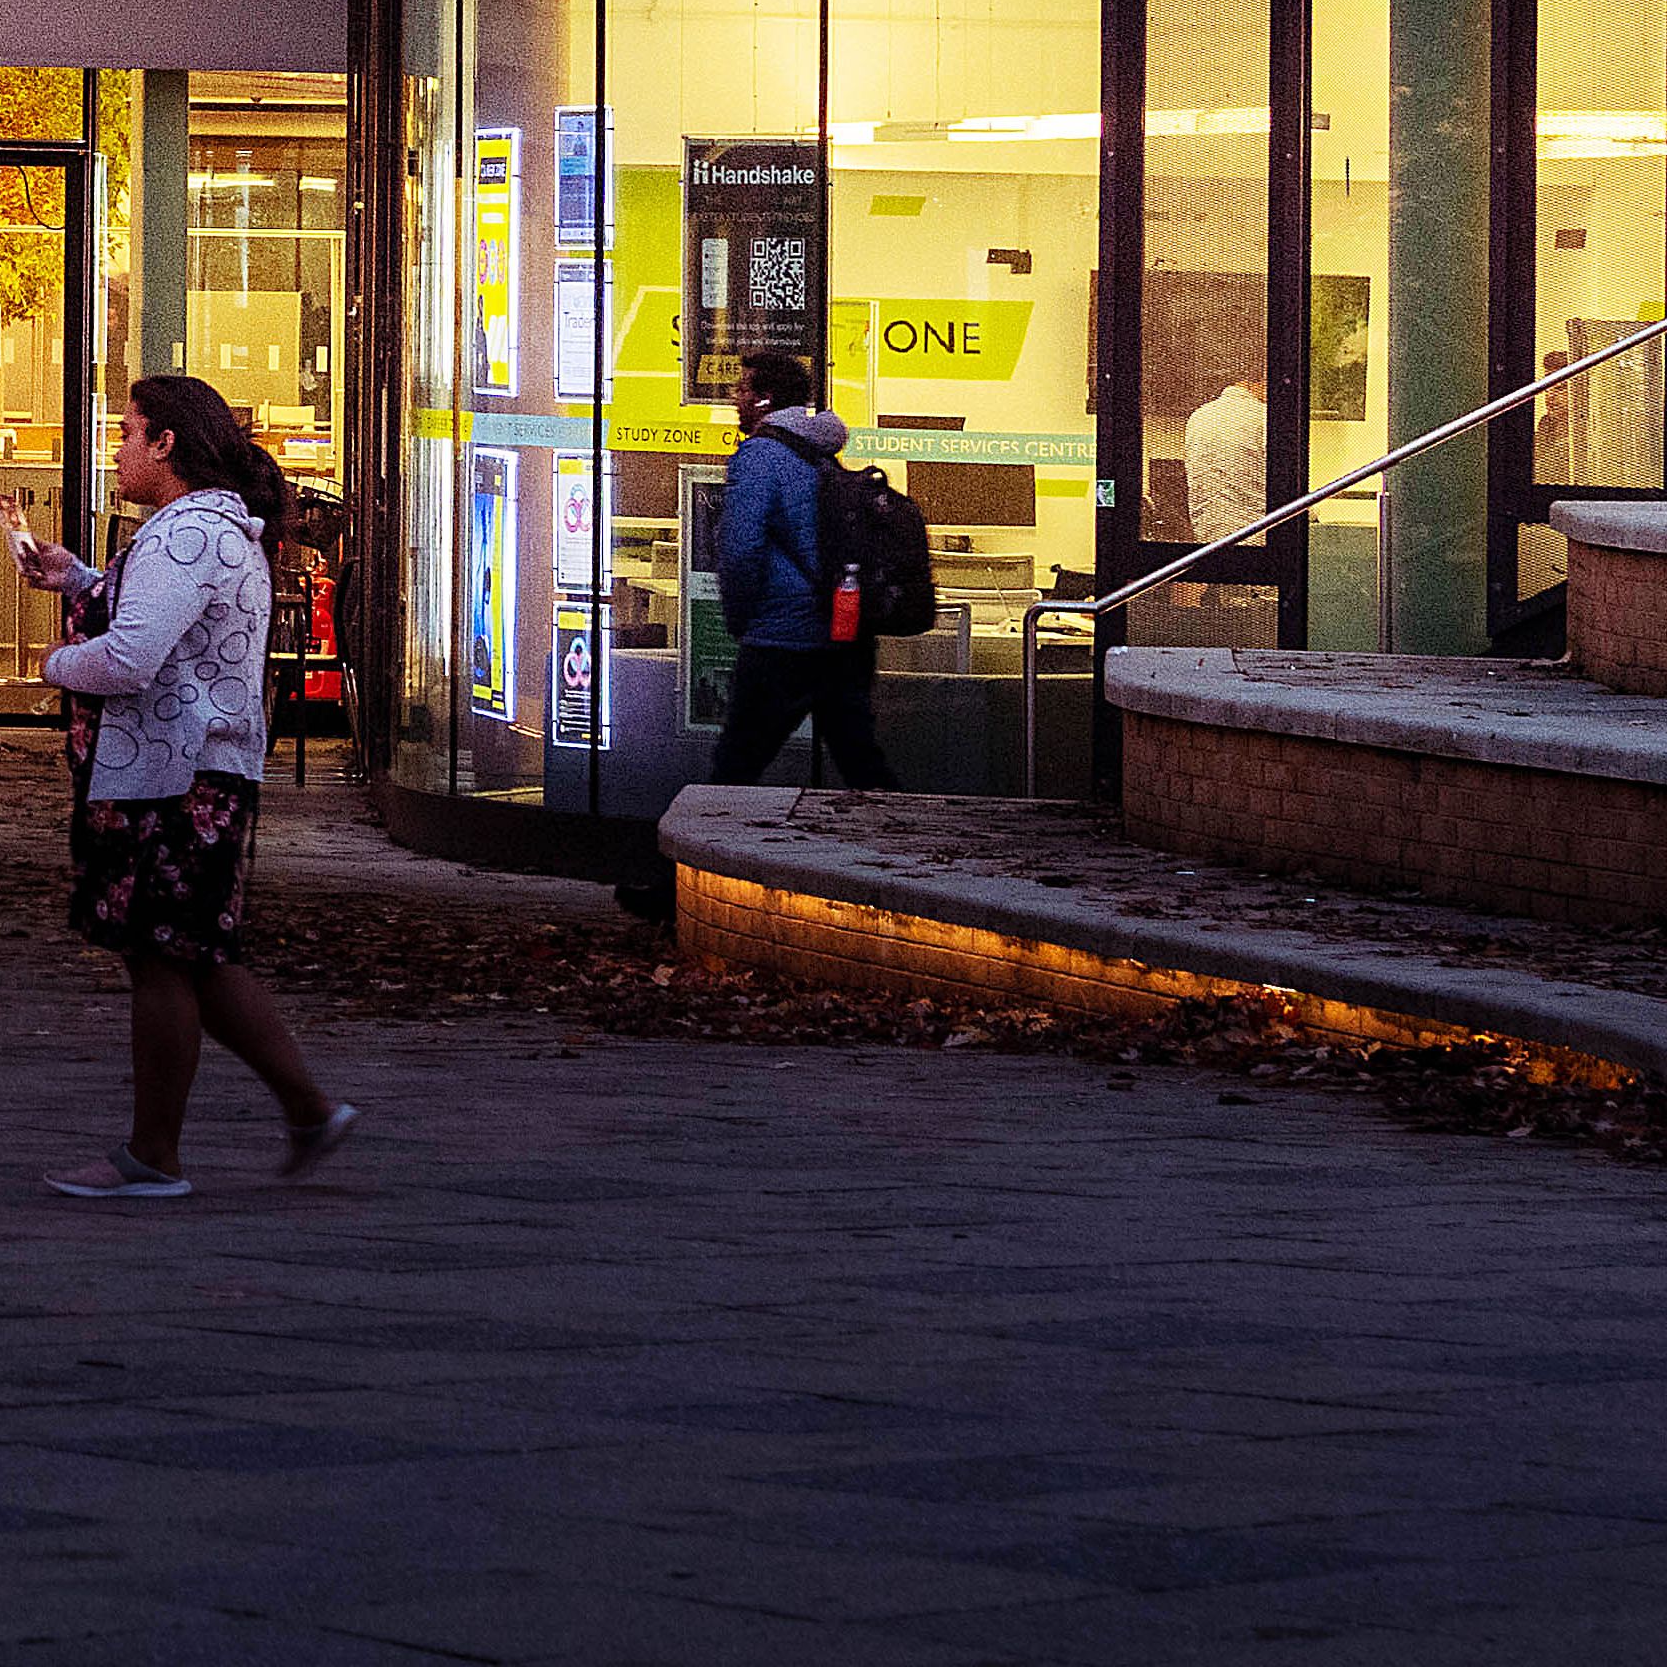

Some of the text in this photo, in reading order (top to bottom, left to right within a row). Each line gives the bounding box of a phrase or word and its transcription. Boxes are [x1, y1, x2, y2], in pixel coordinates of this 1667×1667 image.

[711, 166, 816, 185] Handshake
[883, 319, 981, 355] ONE
[616, 426, 661, 443] STUDY
[663, 427, 702, 444] ZONE
[855, 433, 1096, 458] STUDENT SERVICES CENTRE
